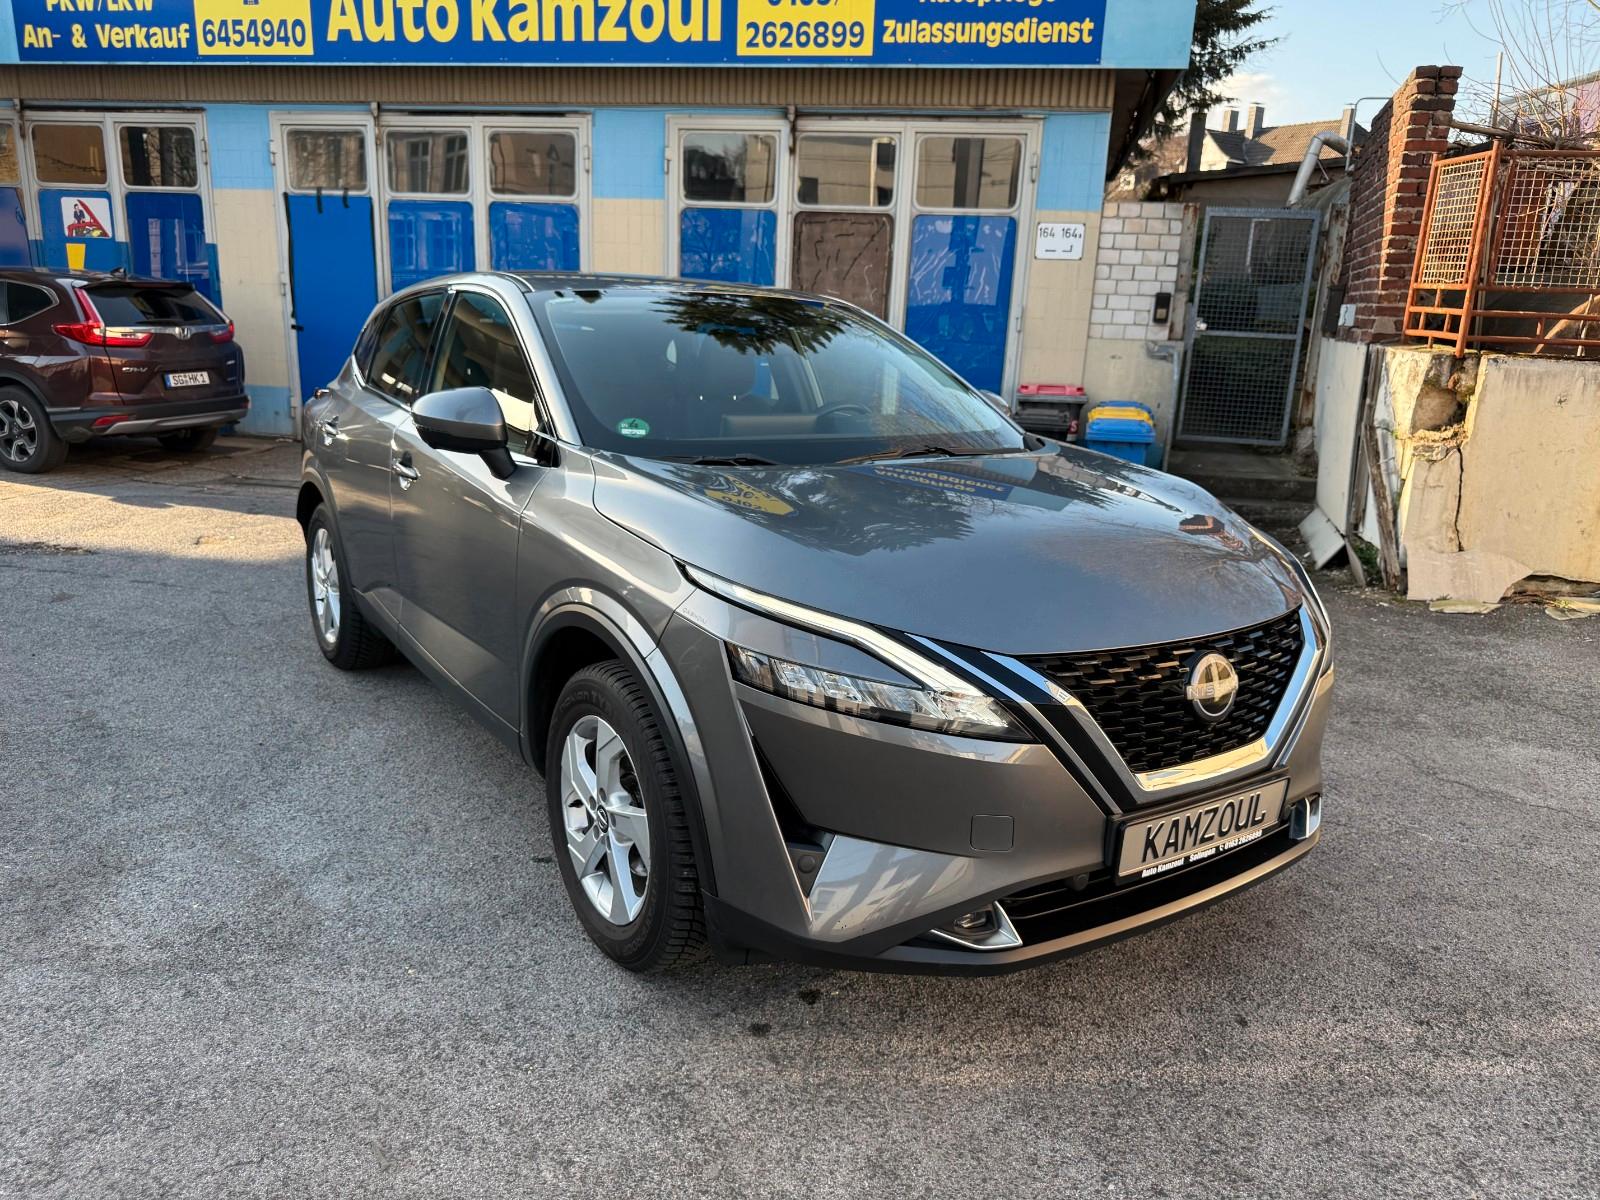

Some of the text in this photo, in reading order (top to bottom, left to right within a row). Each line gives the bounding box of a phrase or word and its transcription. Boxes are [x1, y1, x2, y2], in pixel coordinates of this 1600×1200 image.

[23, 23, 190, 48] An- & Verkauf
[202, 18, 306, 47] 6454940
[327, 0, 722, 43] Auto Kamzoul
[745, 21, 865, 48] 2626899
[882, 17, 1095, 47] Zulassungsdienst
[1039, 227, 1055, 238] 164
[1142, 792, 1266, 863] KAMZOUL
[1142, 867, 1157, 878] Auto
[1158, 858, 1184, 872] Kamzoul
